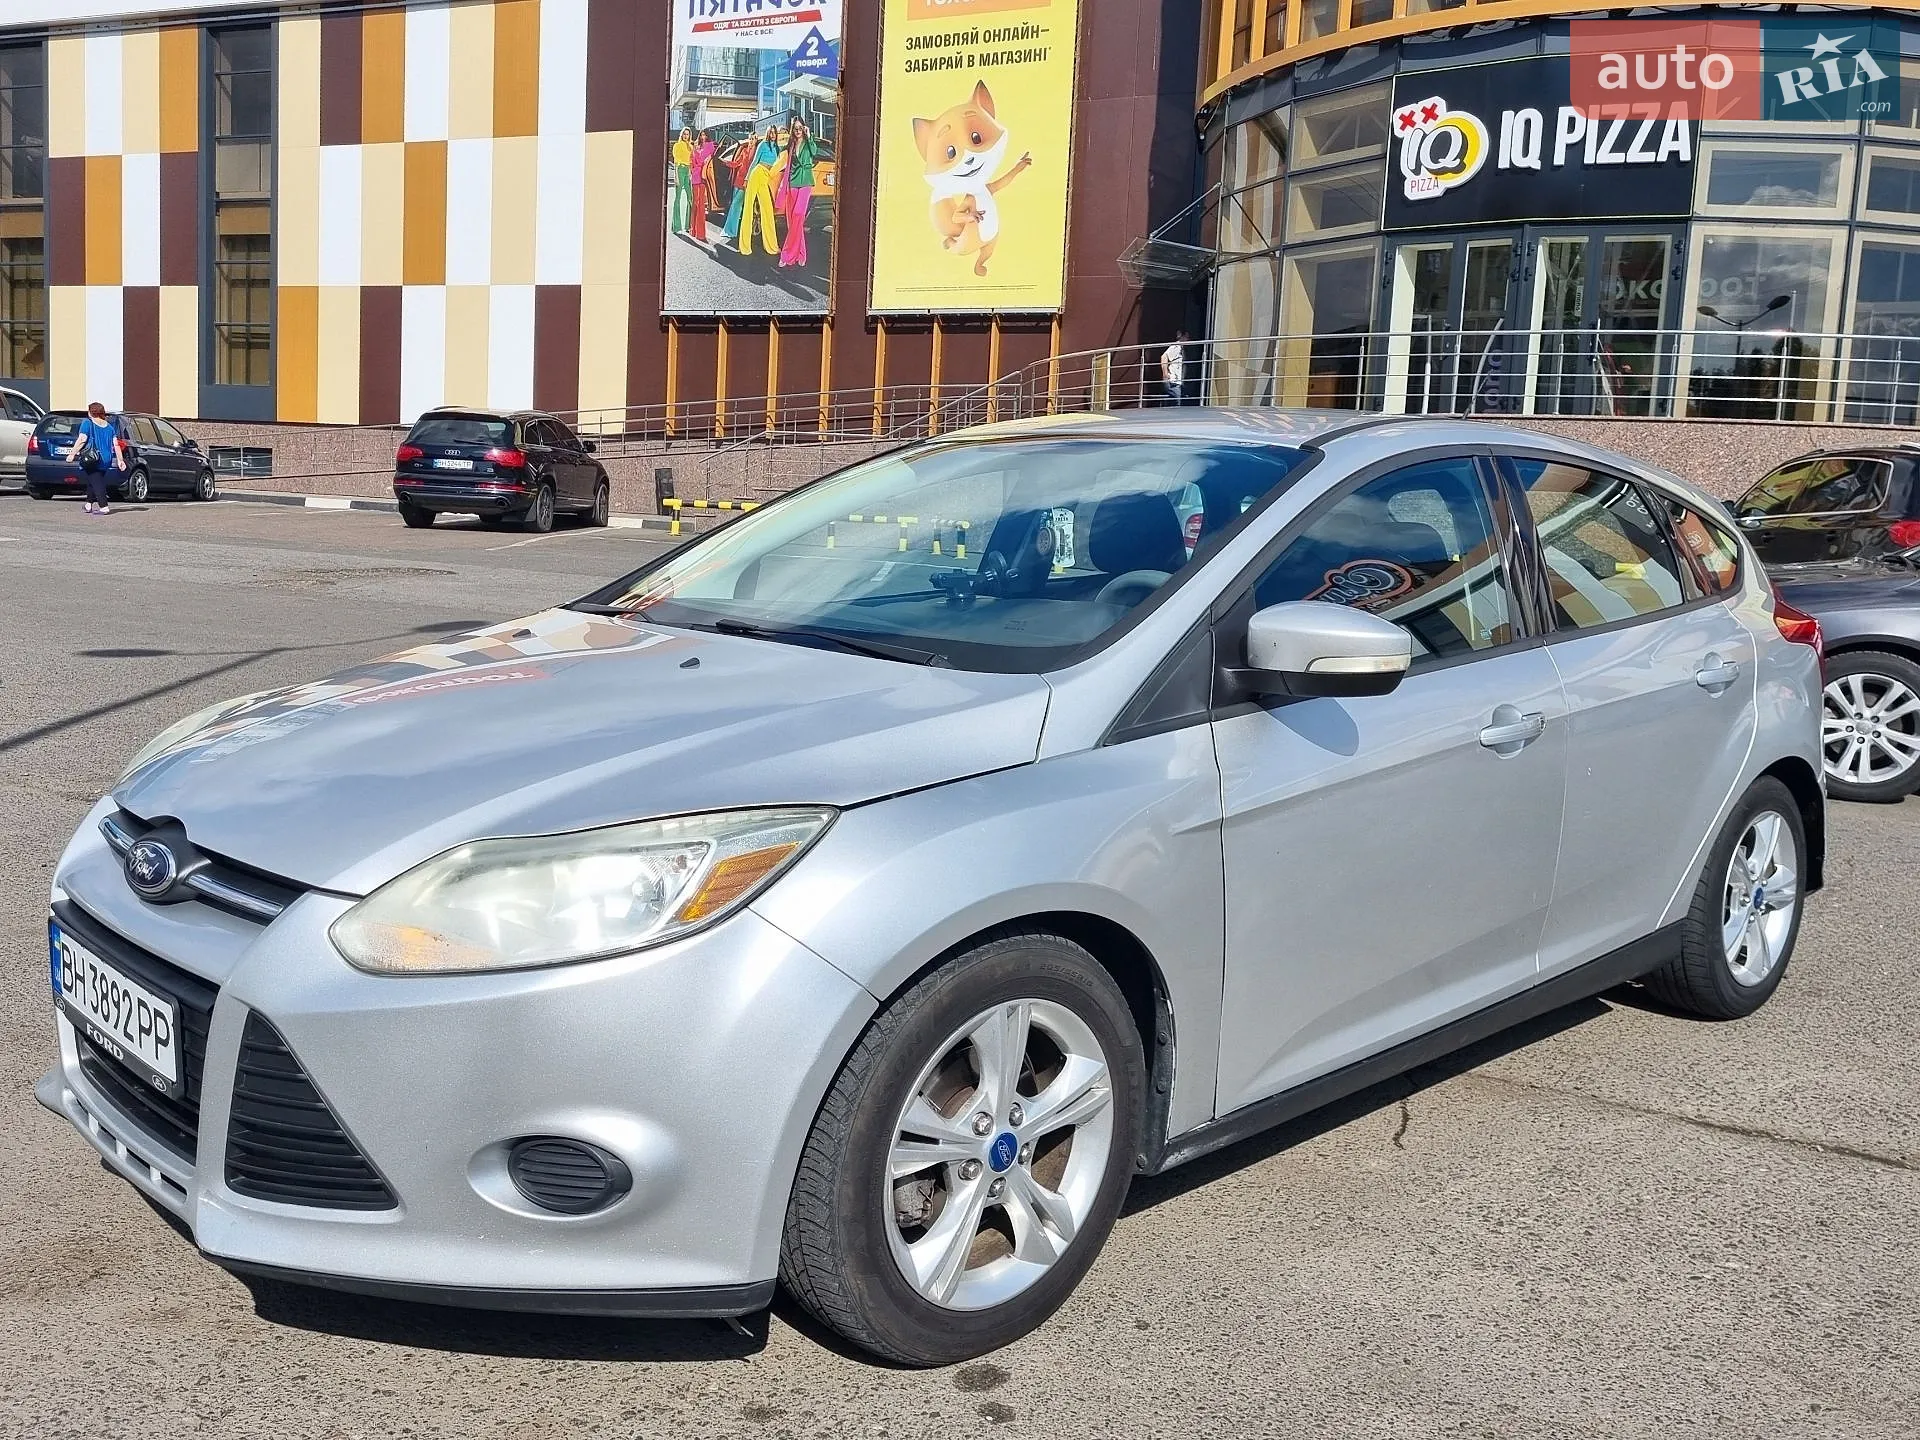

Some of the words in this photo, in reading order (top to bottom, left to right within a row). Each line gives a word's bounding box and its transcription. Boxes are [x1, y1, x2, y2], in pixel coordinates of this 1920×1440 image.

[740, 18, 765, 27] ВЗУТТЯ
[806, 36, 819, 56] 2
[905, 26, 980, 51] ЗАМОВЛЯЙ
[796, 58, 828, 68] поверх
[904, 51, 963, 73] ЗАБИРАЙ
[967, 54, 975, 68] В
[1498, 107, 1544, 171] IQ
[1553, 100, 1692, 166] PIZZA
[1406, 124, 1467, 176] IQ
[1410, 176, 1440, 193] PIZZA
[130, 847, 160, 880] Ford
[86, 1022, 124, 1061] FORD
